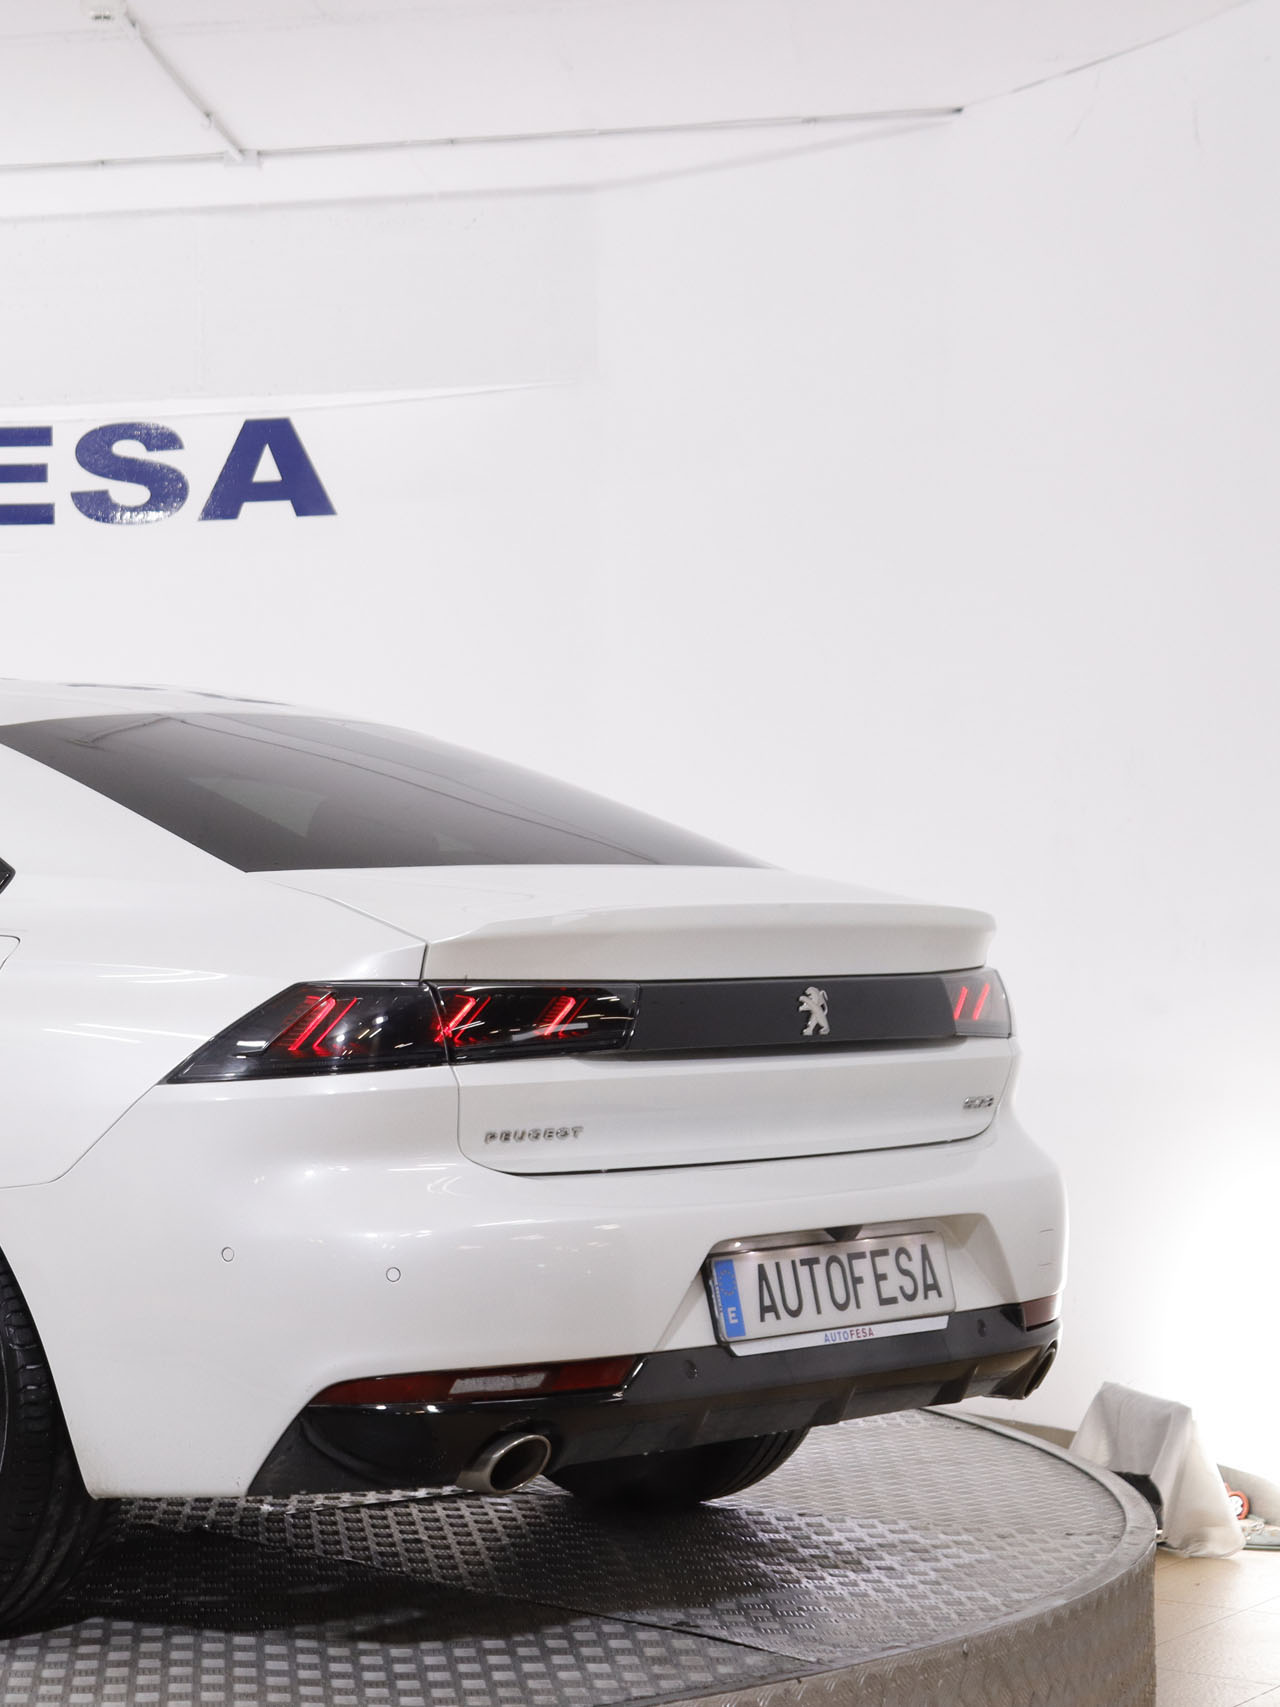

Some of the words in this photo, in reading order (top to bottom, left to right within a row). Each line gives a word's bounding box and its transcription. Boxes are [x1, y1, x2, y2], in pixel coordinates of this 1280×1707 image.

[484, 1126, 584, 1144] PEUGEOT
[757, 1244, 943, 1323] AUTOFESA
[727, 1306, 739, 1324] E
[823, 1327, 875, 1344] AUTOFESA
